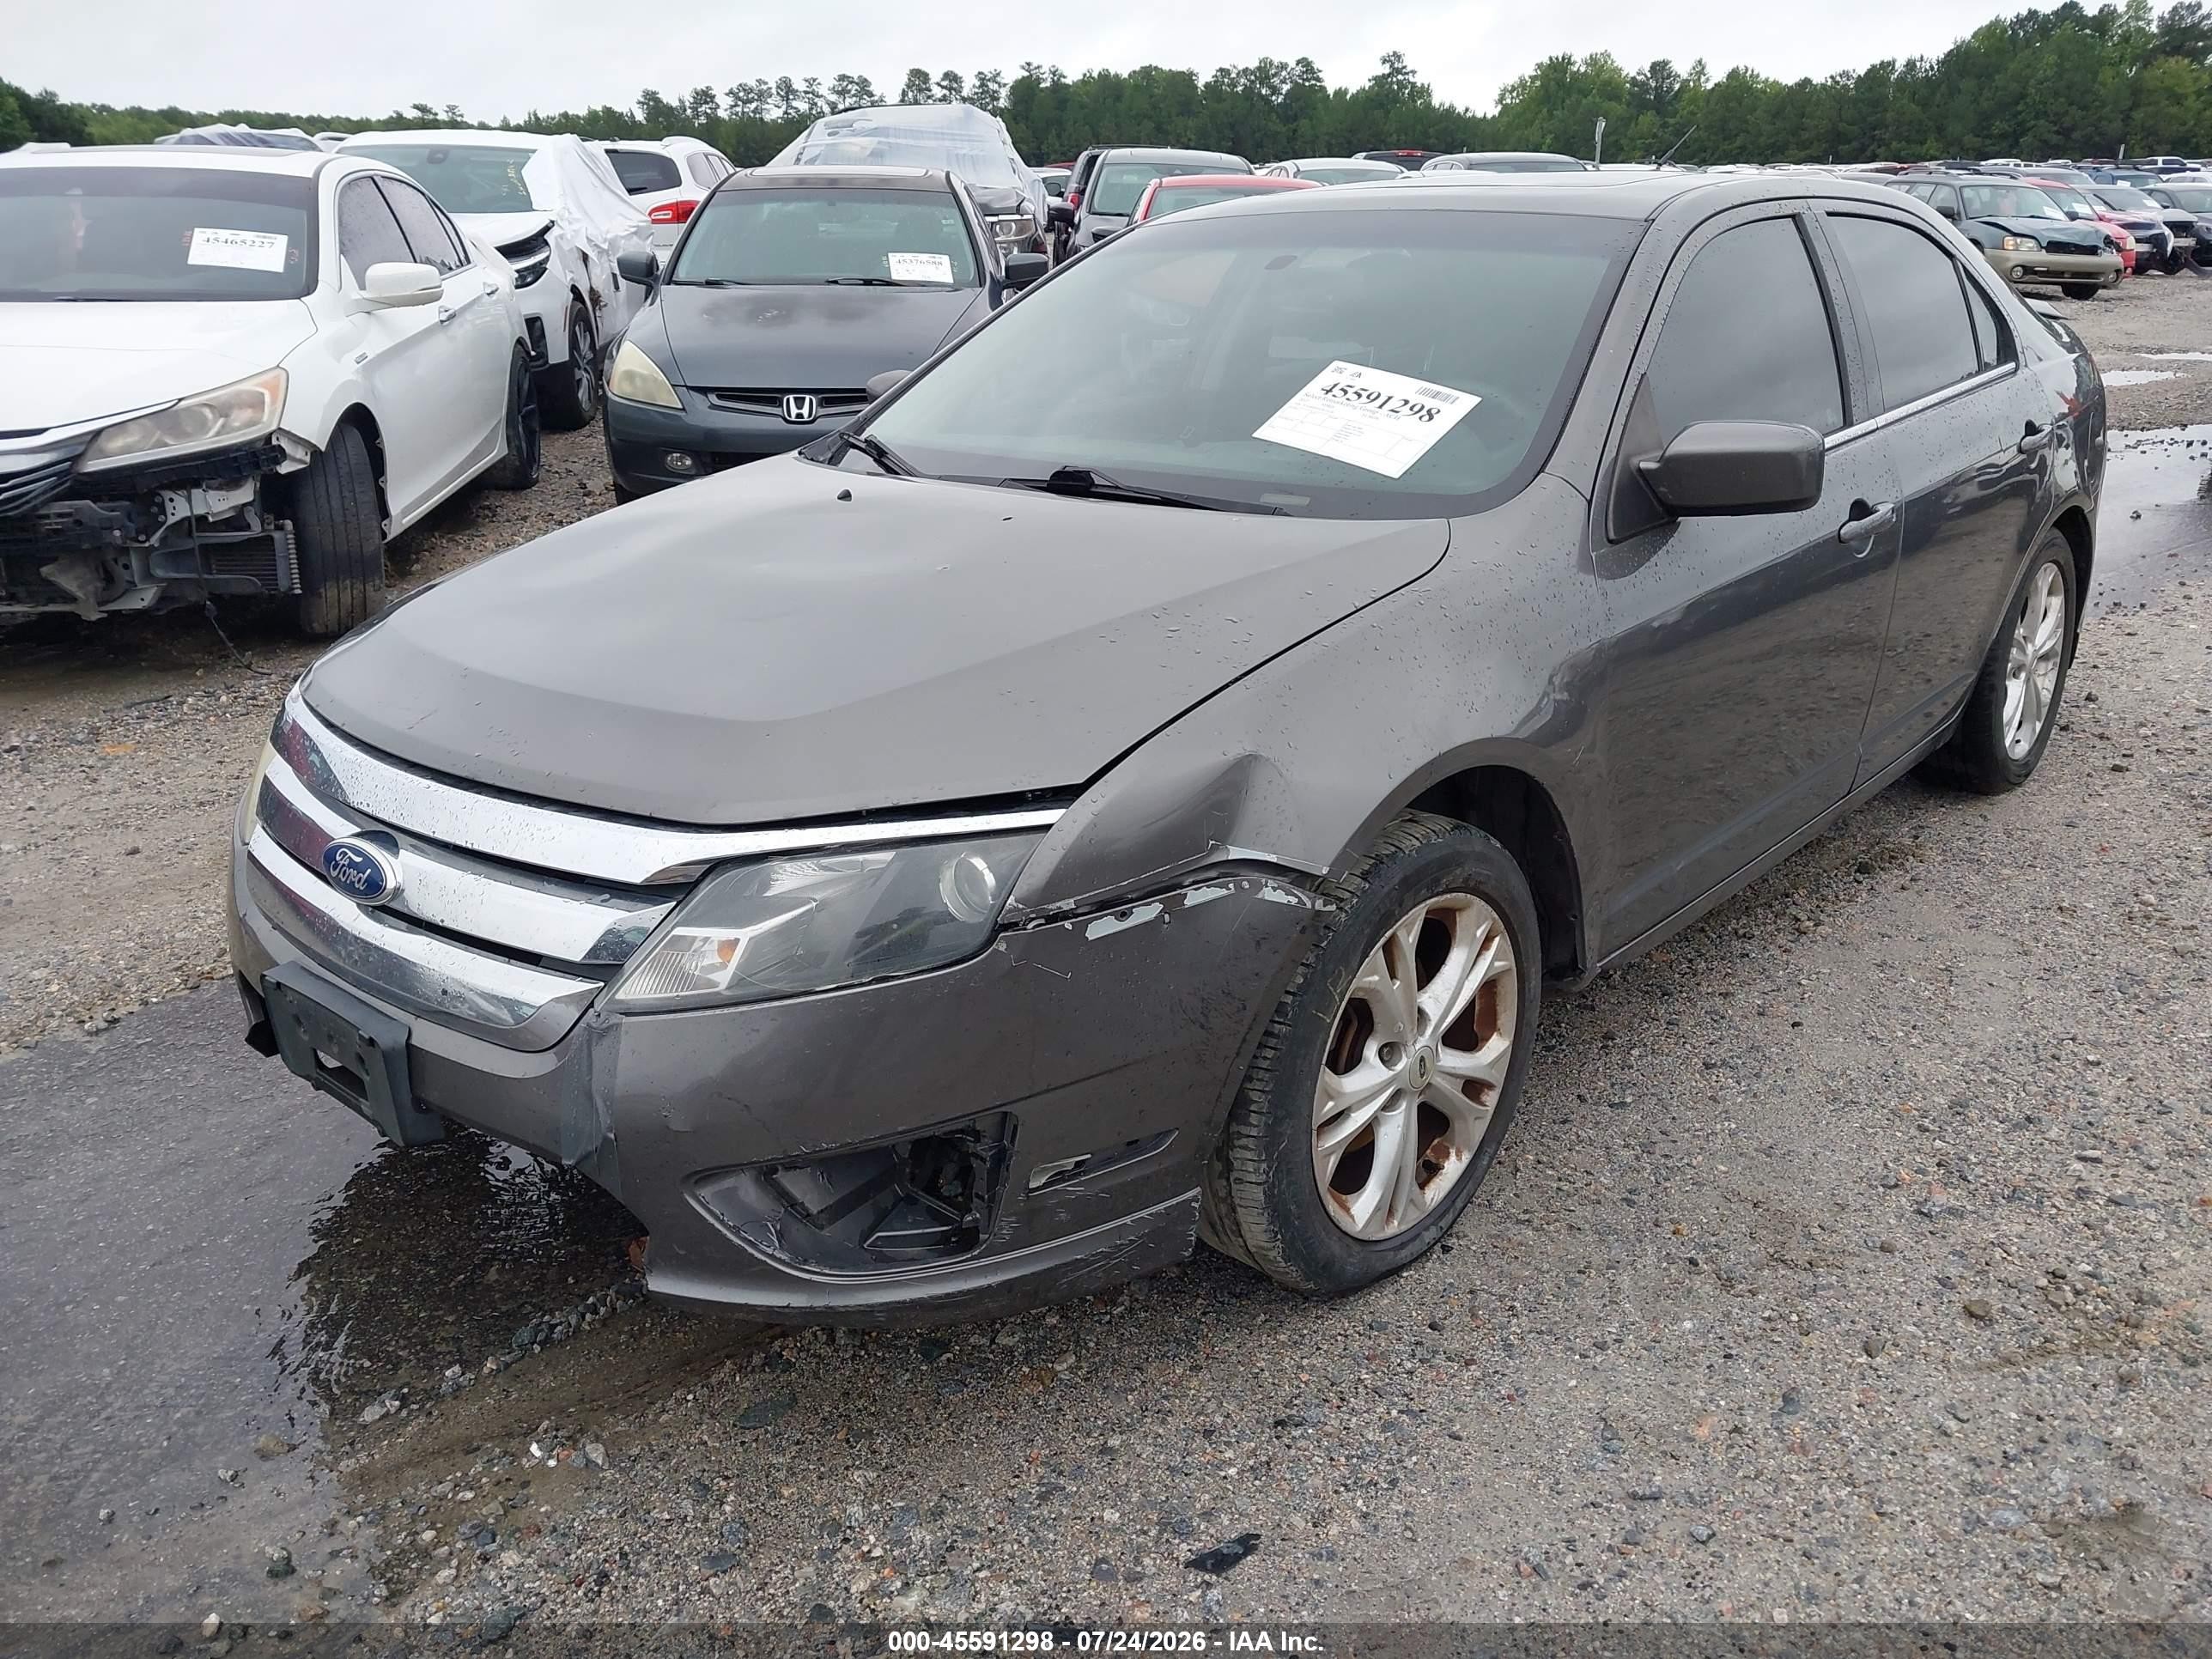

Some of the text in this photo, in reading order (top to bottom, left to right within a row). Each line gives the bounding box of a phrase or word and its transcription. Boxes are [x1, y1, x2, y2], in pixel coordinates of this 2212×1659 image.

[202, 236, 276, 249] 45465227
[1320, 381, 1442, 423] 45591298
[330, 848, 372, 890] Ford
